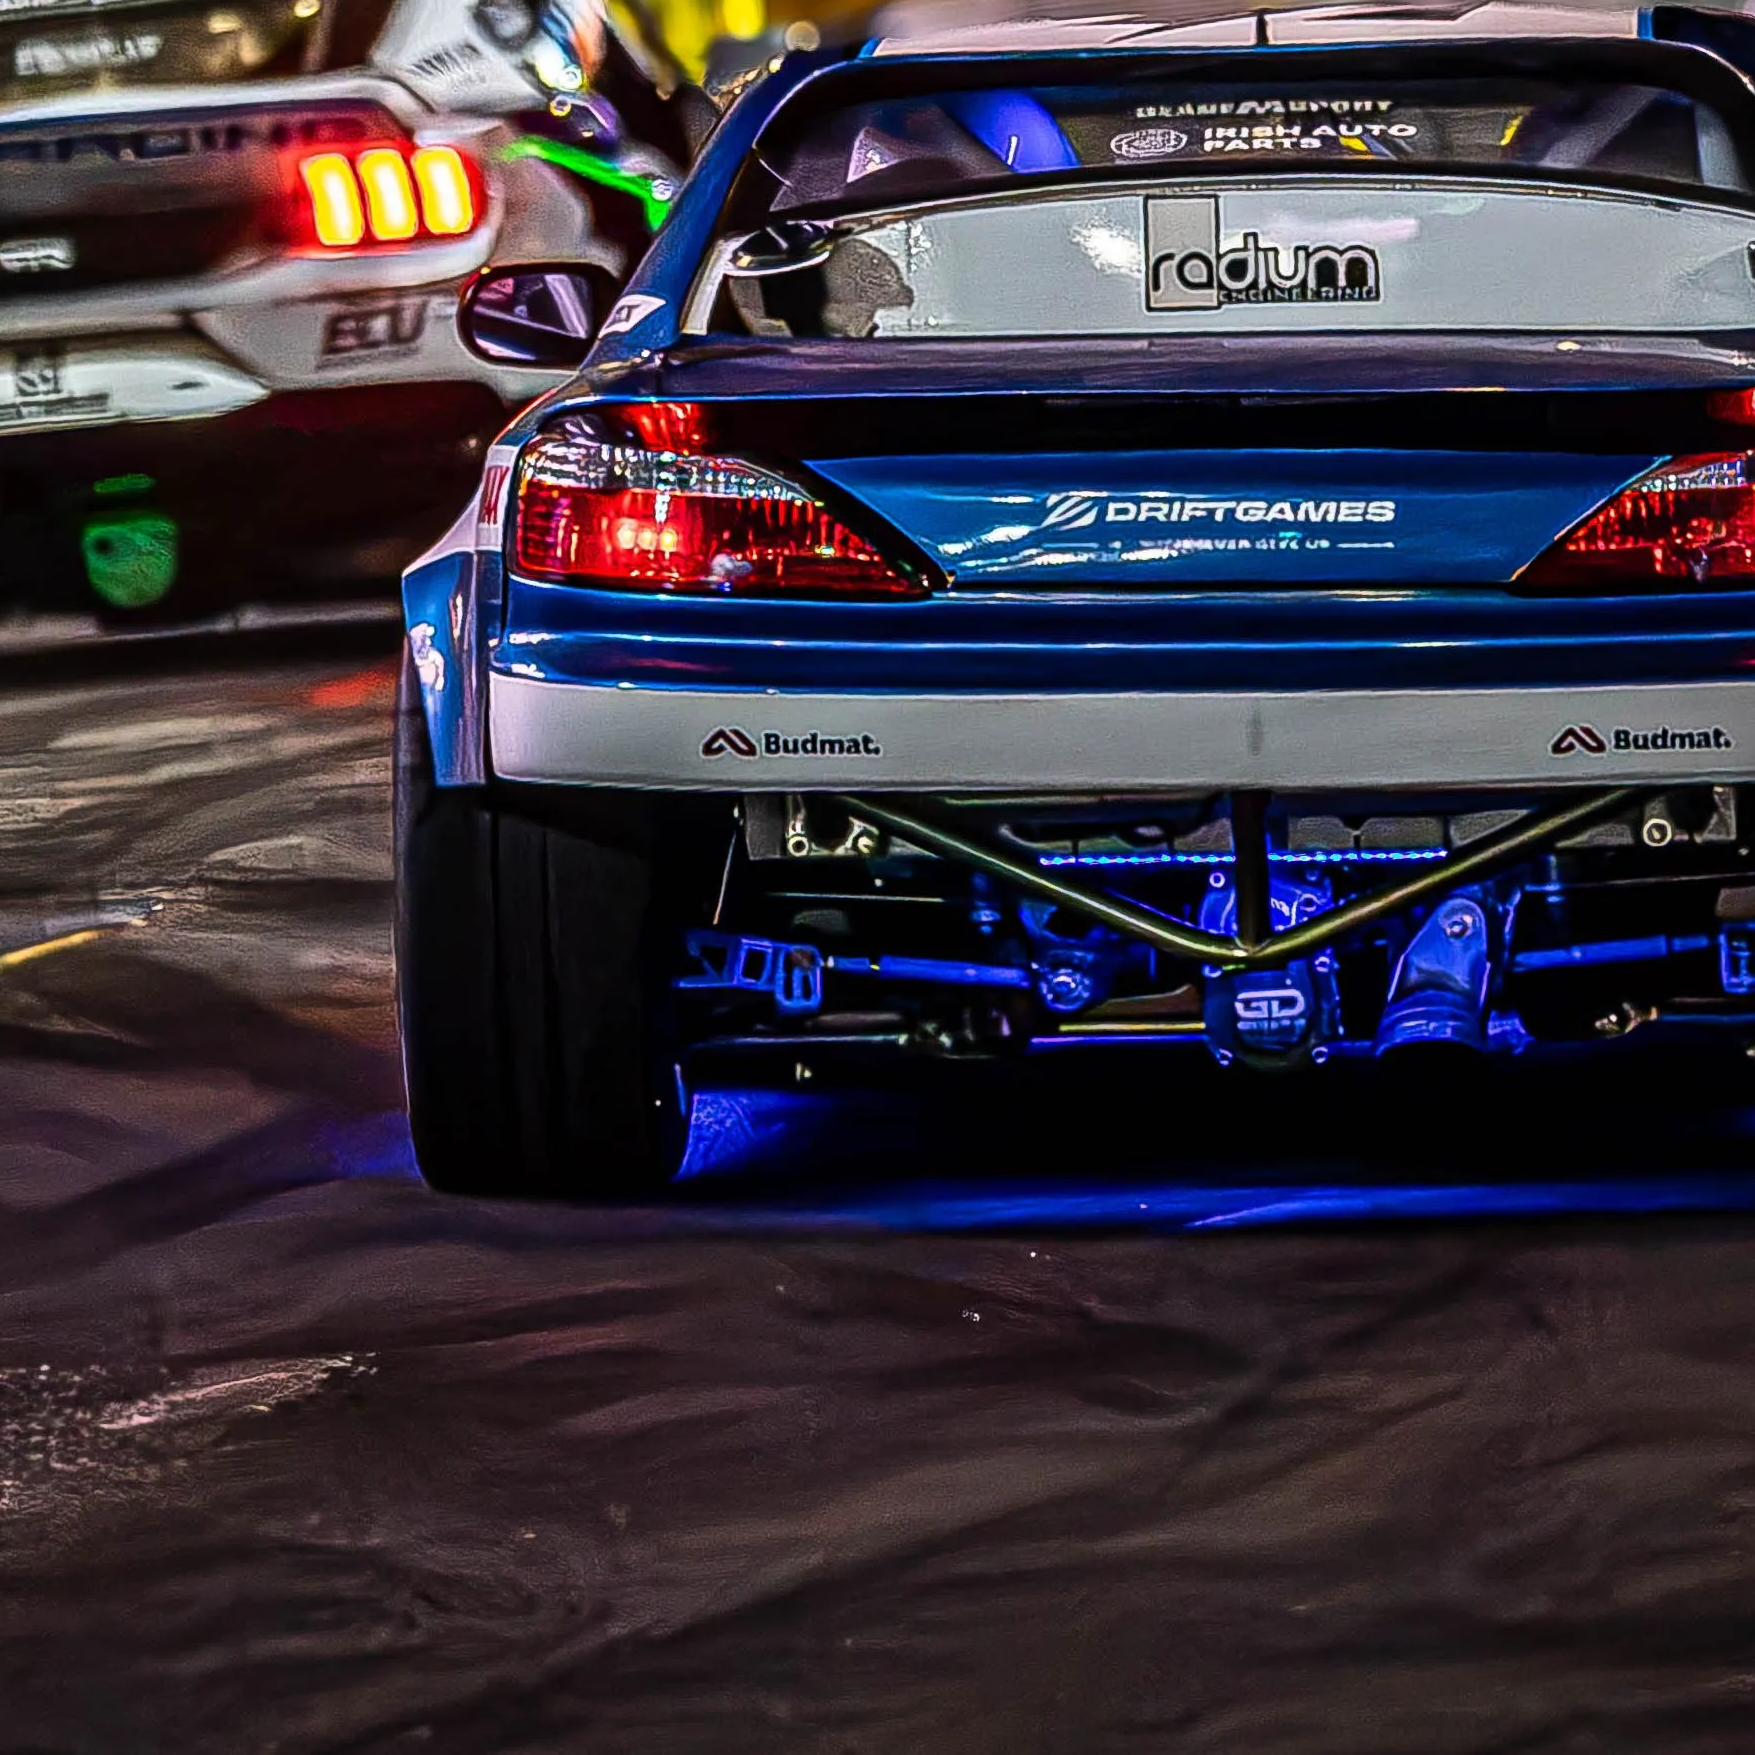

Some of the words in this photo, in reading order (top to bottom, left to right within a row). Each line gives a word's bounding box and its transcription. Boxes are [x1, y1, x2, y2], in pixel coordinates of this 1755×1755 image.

[1203, 125, 1302, 140] IRISH
[1312, 123, 1419, 138] AUTO
[1203, 137, 1322, 152] PARTS
[1151, 231, 1382, 294] radium
[322, 299, 429, 355] ECU
[1105, 499, 1396, 523] DRIFTGAMES
[762, 731, 881, 756] Budmat.
[1612, 726, 1732, 751] Budmat.
